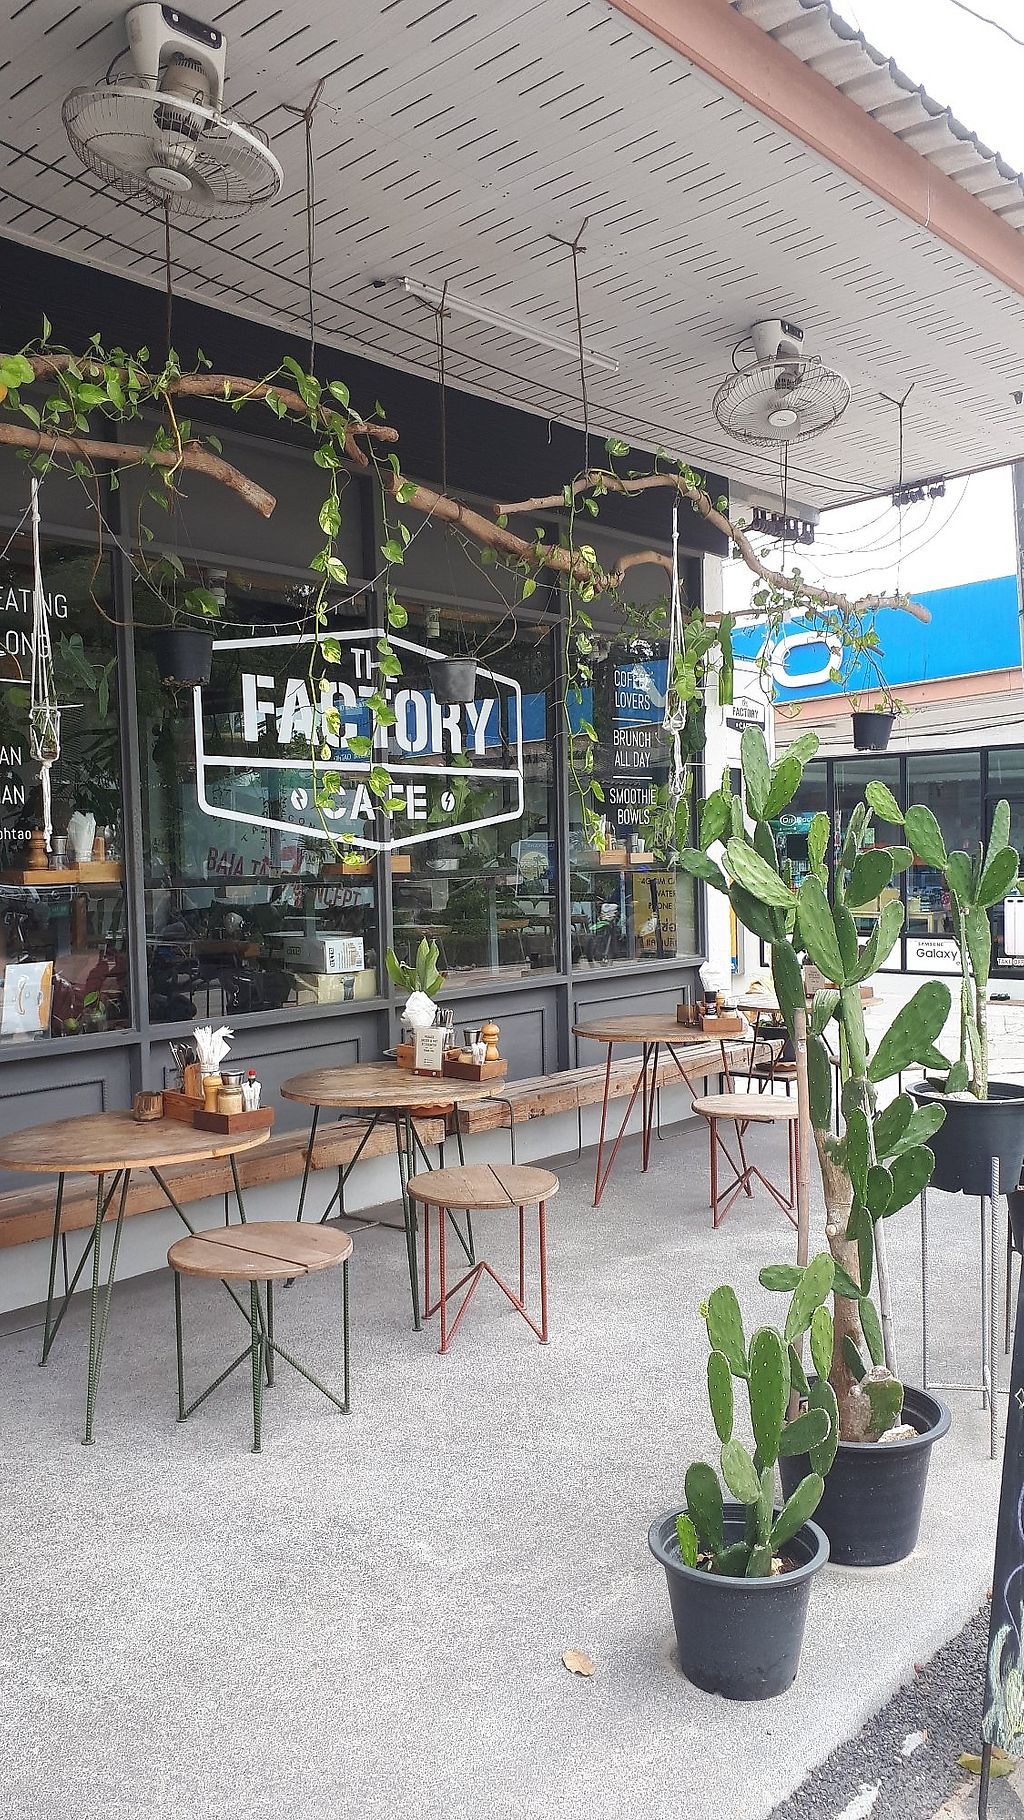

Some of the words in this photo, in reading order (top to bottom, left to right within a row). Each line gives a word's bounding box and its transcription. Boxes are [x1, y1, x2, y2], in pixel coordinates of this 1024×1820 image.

[351, 648, 399, 683] TH
[614, 670, 651, 691] COFFEE
[614, 691, 651, 711] LOVERS
[241, 673, 495, 755] FACTORY
[613, 729, 651, 748] BRUNCH
[614, 750, 631, 767] ALL
[633, 751, 651, 768] DAY
[321, 783, 427, 821] CAFE
[609, 787, 657, 805] SMOOTHIE
[617, 808, 650, 825] BOWLS
[648, 902, 672, 910] PONE
[916, 948, 958, 961] Galaxy
